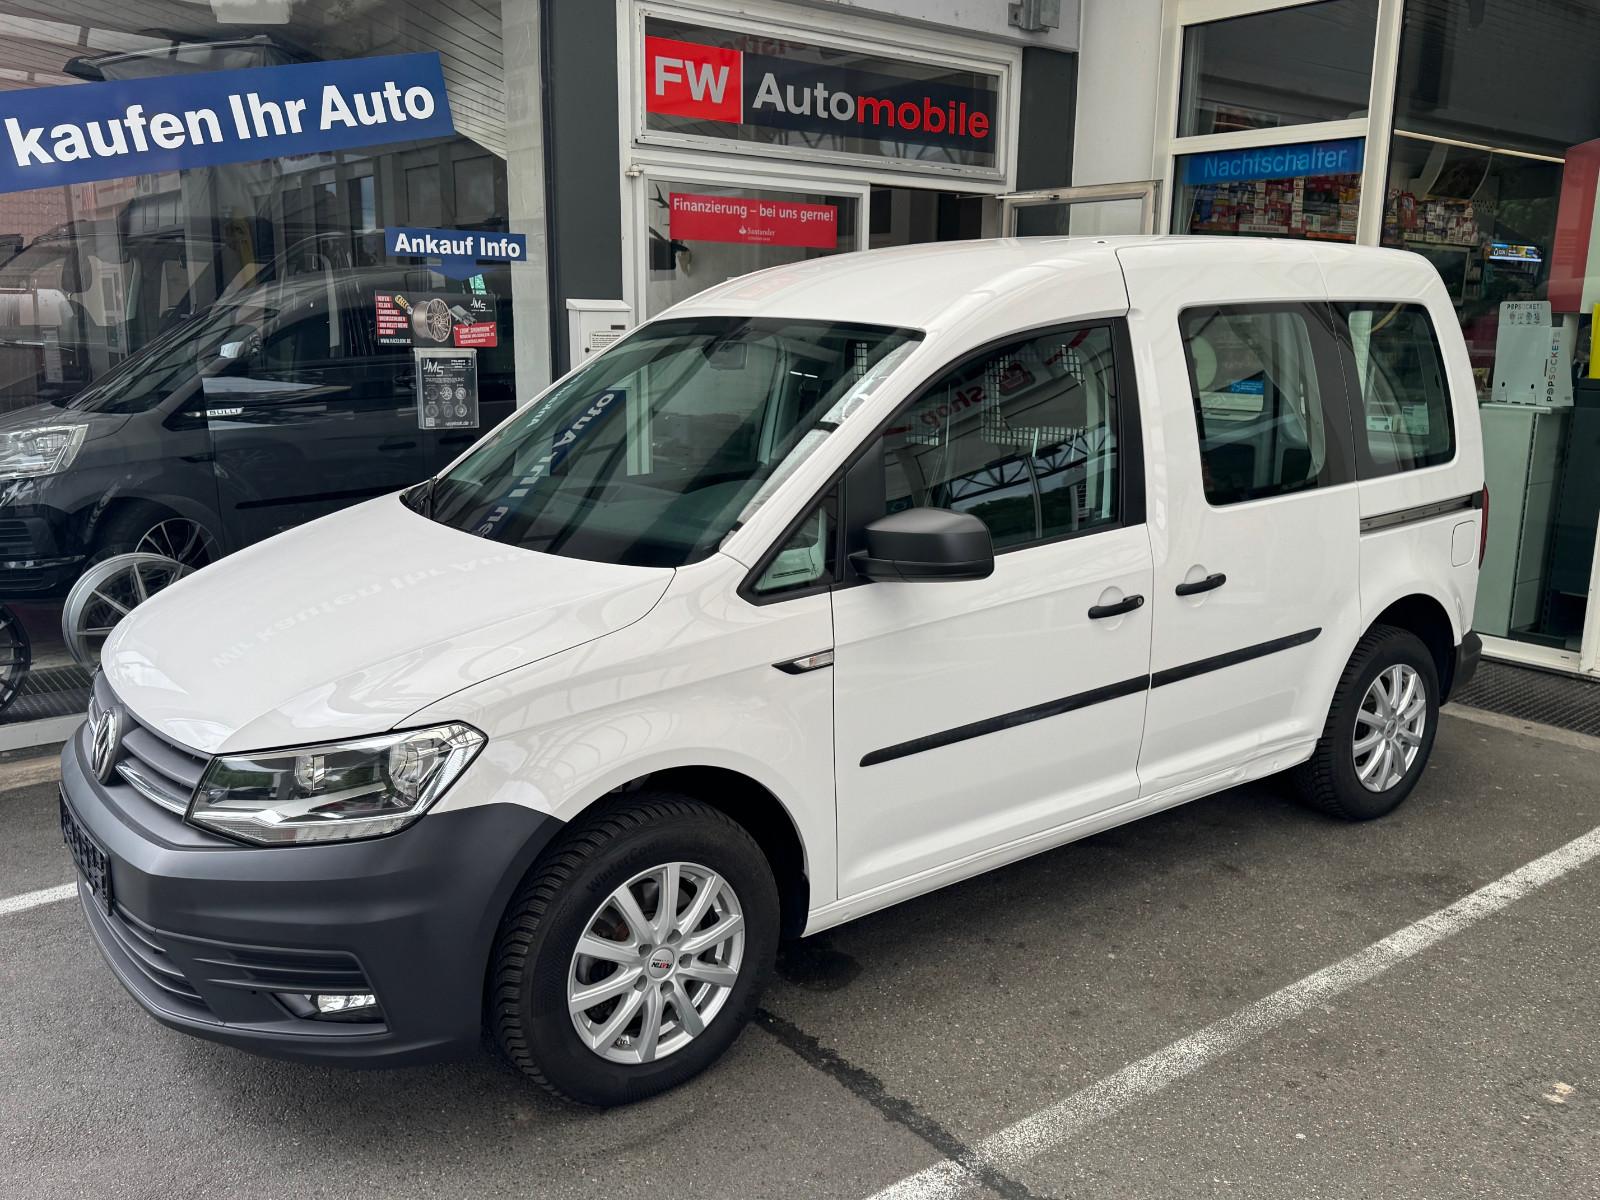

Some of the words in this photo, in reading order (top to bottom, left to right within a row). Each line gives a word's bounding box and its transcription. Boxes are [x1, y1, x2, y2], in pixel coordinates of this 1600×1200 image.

[654, 55, 730, 104] FW
[752, 72, 990, 139] Automobile
[4, 104, 223, 168] kaufen
[228, 92, 307, 141] Ihr
[320, 81, 436, 131] Auto
[1204, 147, 1348, 178] Nachtschalter
[673, 198, 747, 219] Finanzierung
[759, 204, 776, 218] bei
[779, 208, 798, 219] uns
[800, 209, 834, 223] gerne!
[394, 232, 473, 256] Ankauf
[479, 236, 521, 259] Info
[423, 358, 445, 377] JMS
